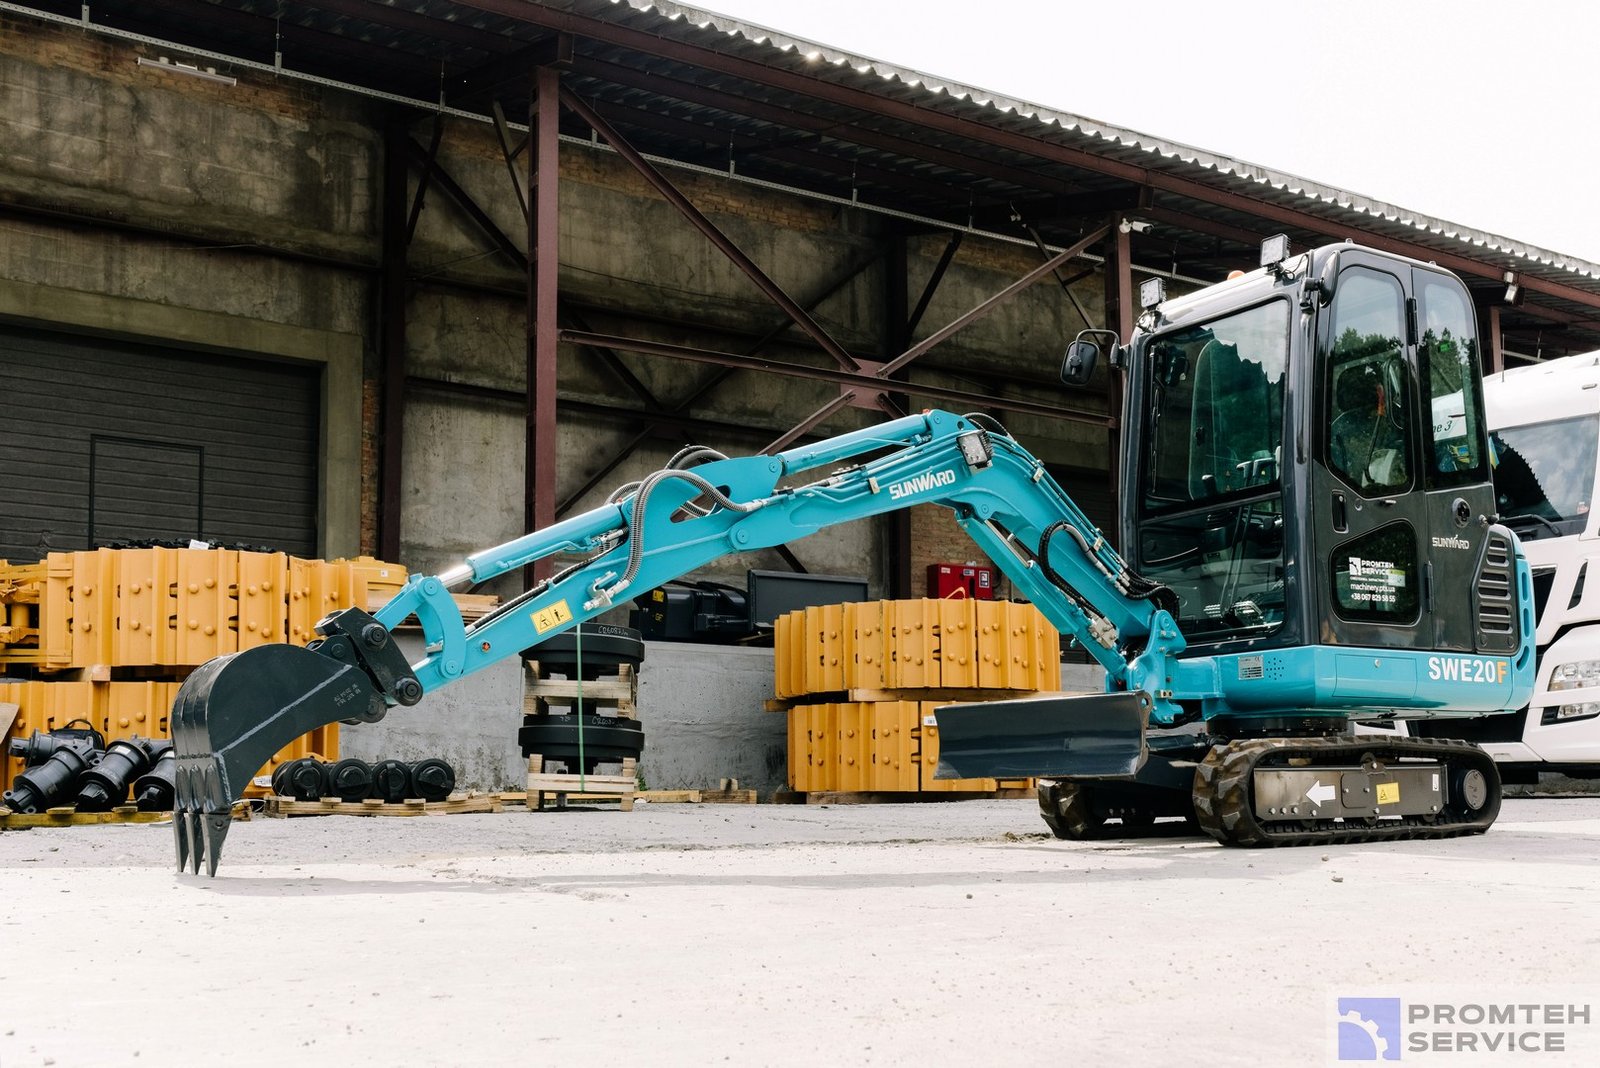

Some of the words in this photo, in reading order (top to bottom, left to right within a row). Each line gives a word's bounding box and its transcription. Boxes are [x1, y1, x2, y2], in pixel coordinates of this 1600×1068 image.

[889, 469, 956, 500] SUNWARD
[1432, 534, 1469, 549] SUNWARD
[1361, 560, 1394, 568] PROMTEH
[1428, 656, 1507, 684] SWE20F
